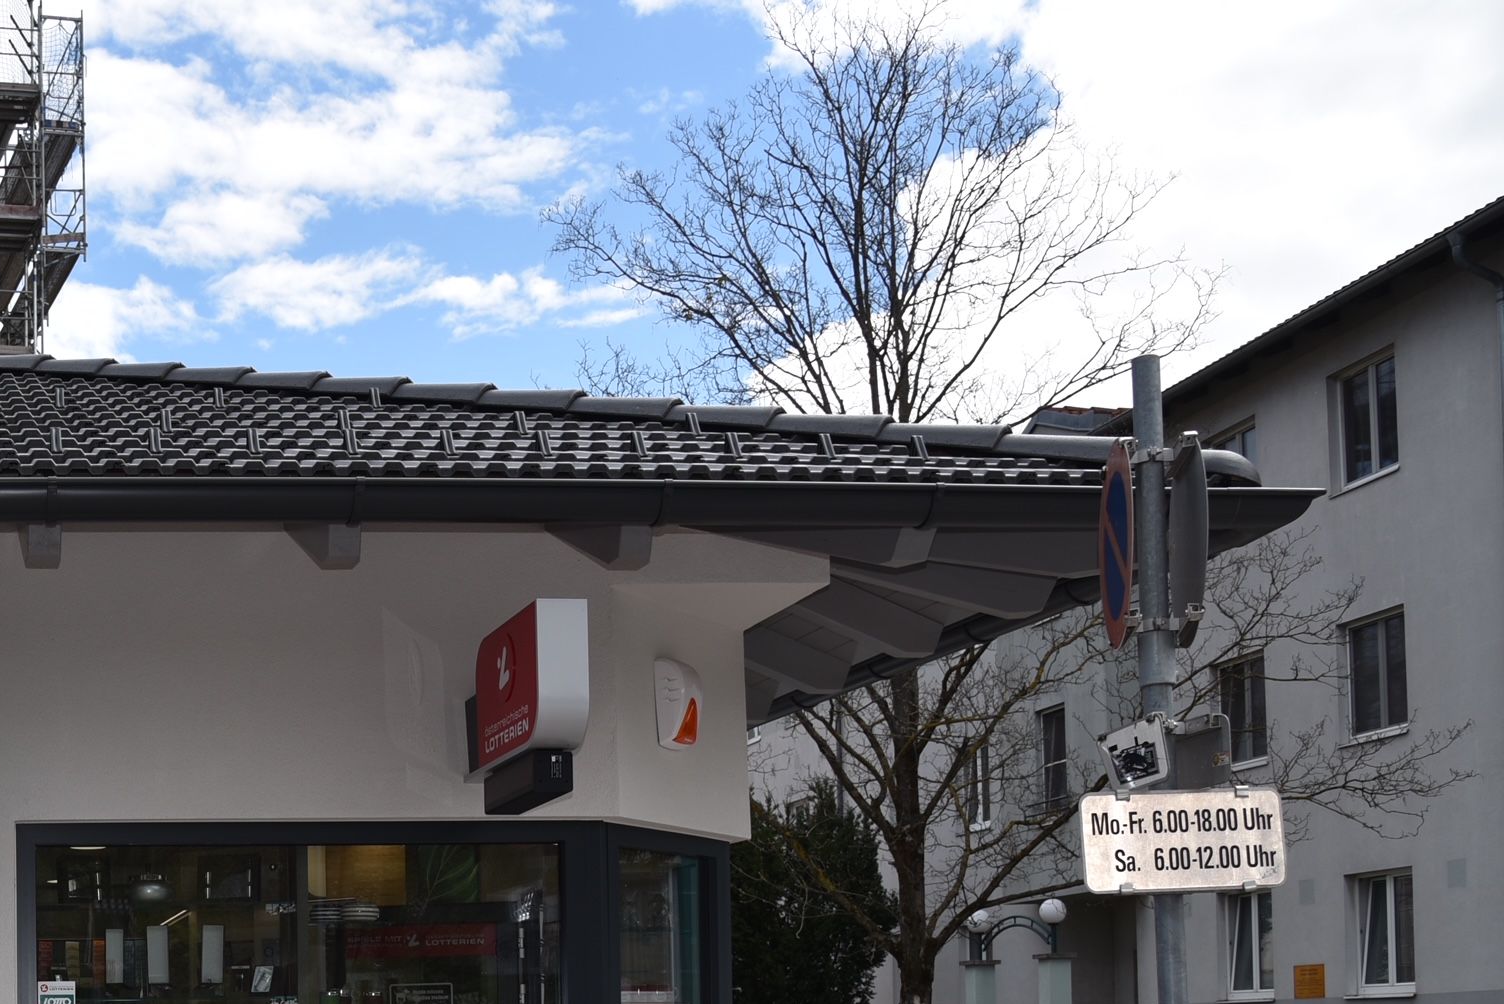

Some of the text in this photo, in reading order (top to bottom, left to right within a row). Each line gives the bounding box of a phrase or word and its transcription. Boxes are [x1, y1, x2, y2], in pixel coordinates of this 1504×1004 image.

[485, 717, 528, 753] LOTTERIEN
[1091, 807, 1273, 835] Mo.-Fr. 6.00-18.00 Uhr
[1115, 844, 1276, 872] Sa. 6.00-12.00 Uhr
[425, 938, 485, 946] LOTTERIEN
